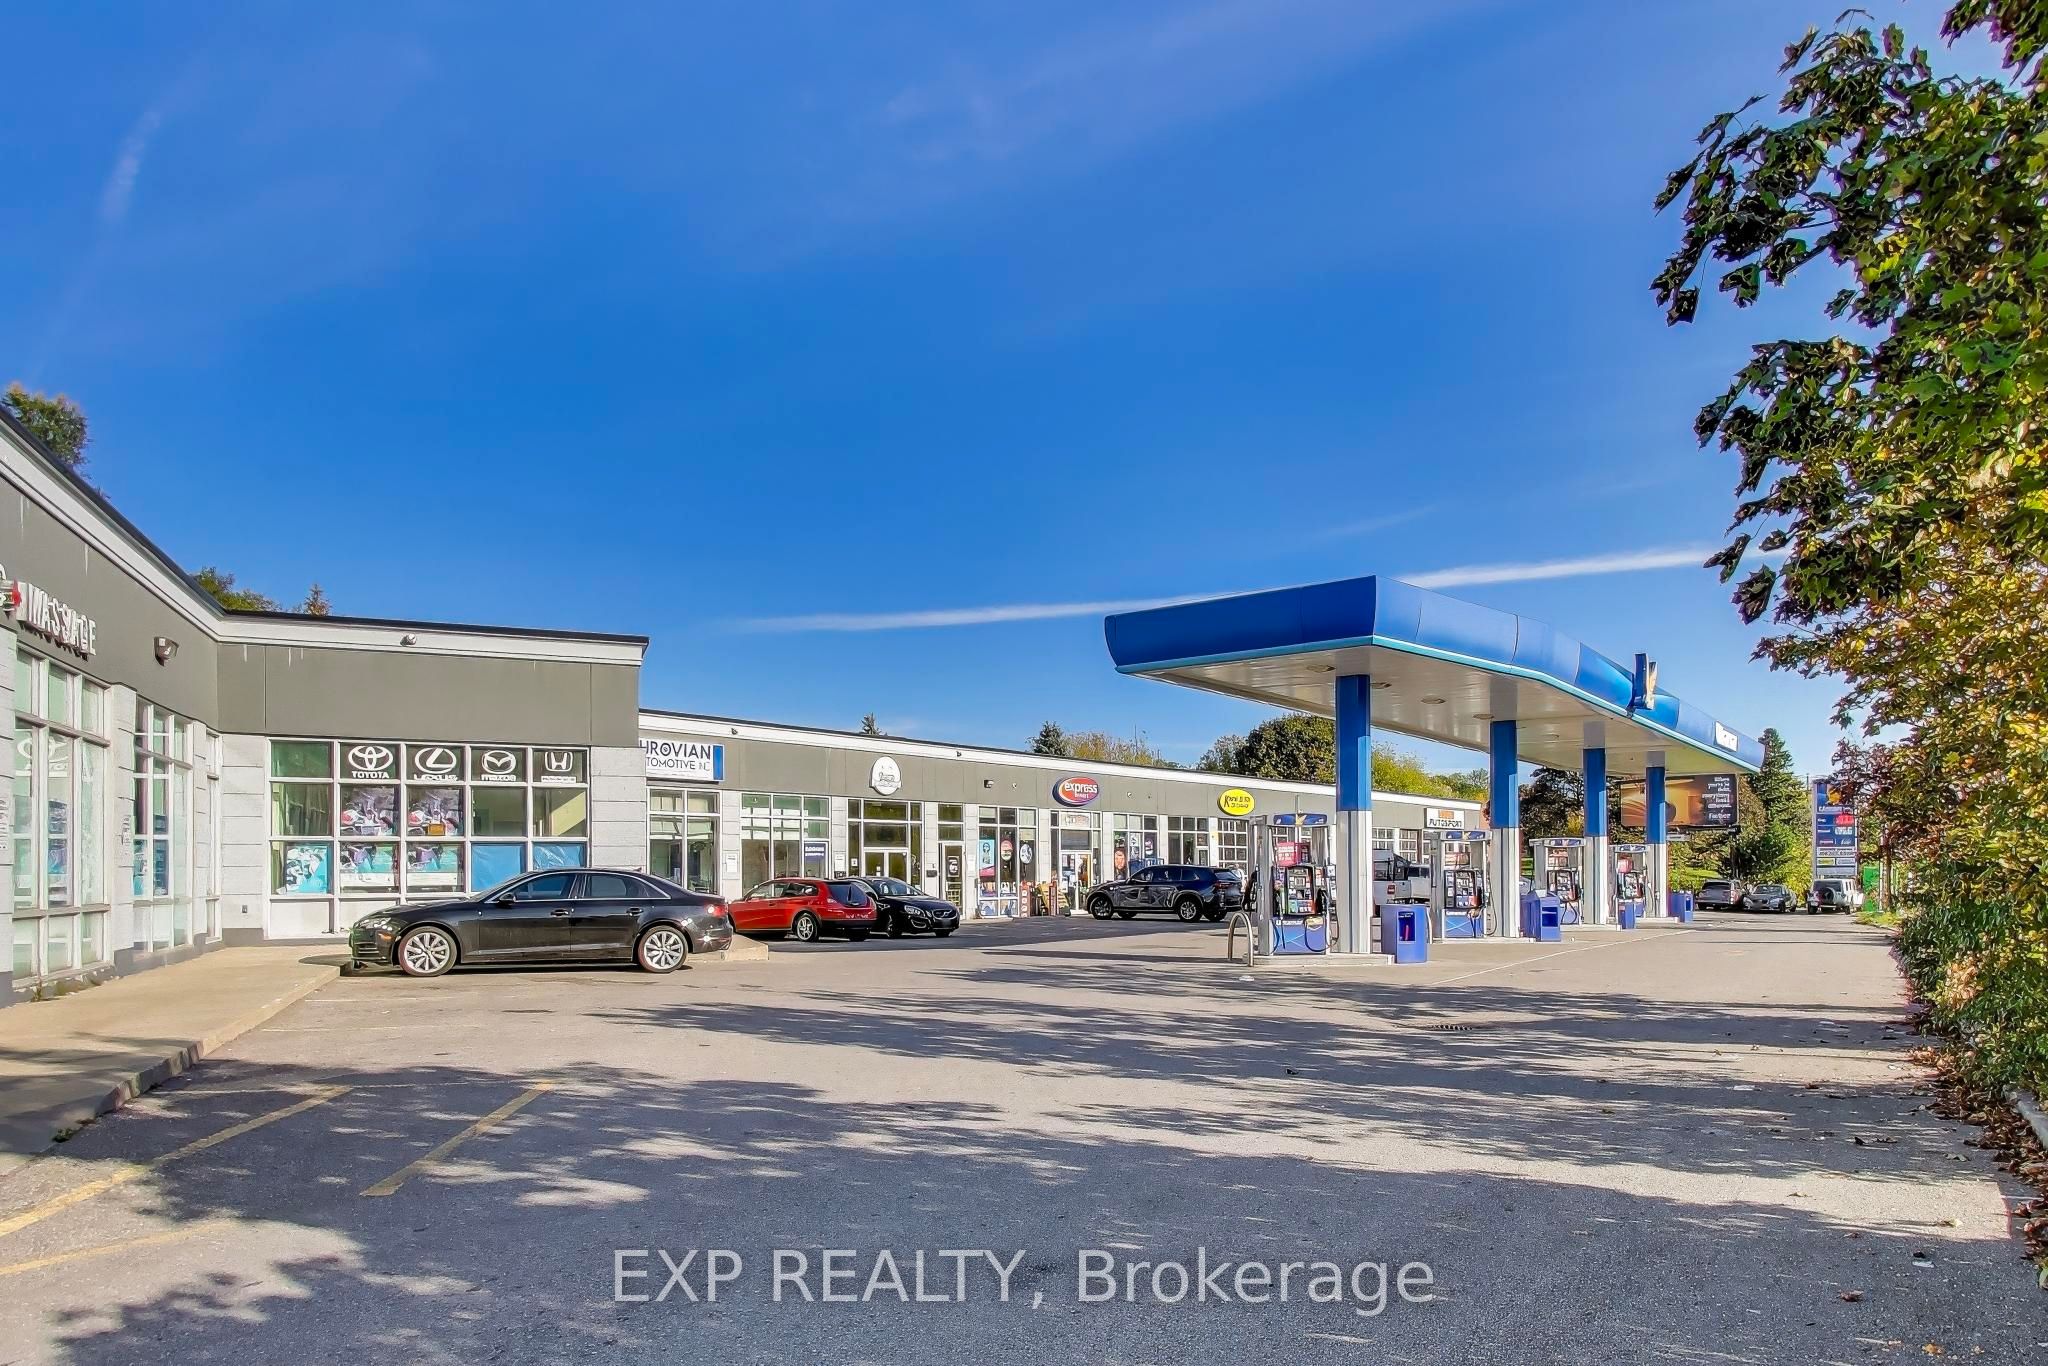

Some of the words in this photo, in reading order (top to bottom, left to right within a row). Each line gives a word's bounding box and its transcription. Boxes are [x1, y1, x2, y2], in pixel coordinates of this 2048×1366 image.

[27, 583, 97, 656] MASSAGE
[646, 756, 696, 770] TOMOTIVE
[351, 770, 390, 779] TOYOTA
[1064, 782, 1098, 796] express
